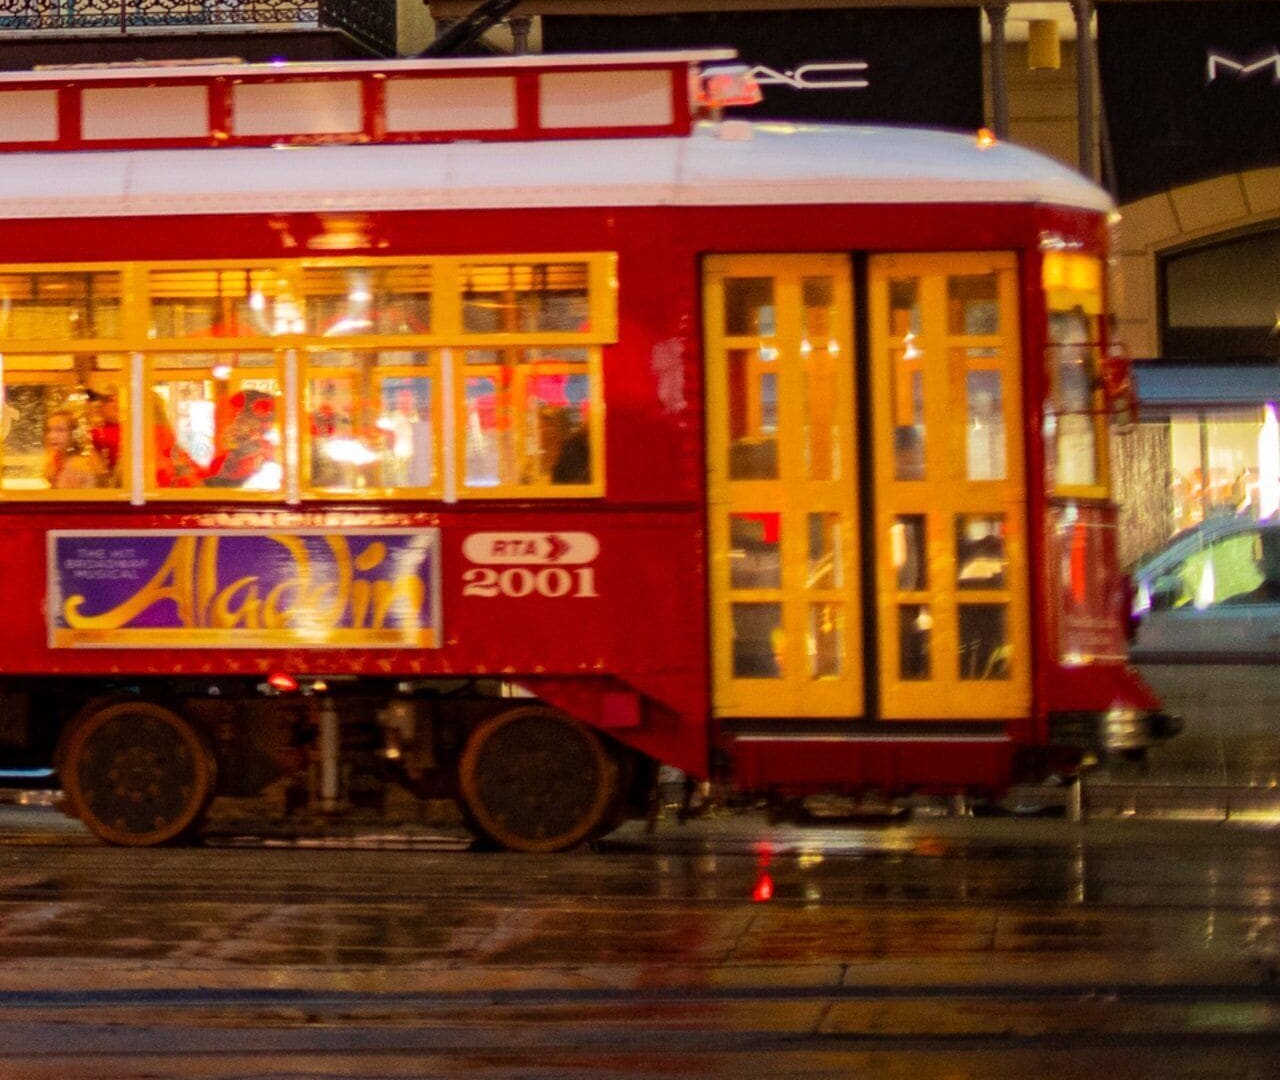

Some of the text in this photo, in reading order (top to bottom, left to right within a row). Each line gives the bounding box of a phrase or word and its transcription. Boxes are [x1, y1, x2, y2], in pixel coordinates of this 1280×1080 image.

[491, 539, 538, 556] RTA
[64, 535, 426, 628] Aladdin
[461, 567, 601, 598] 2001
